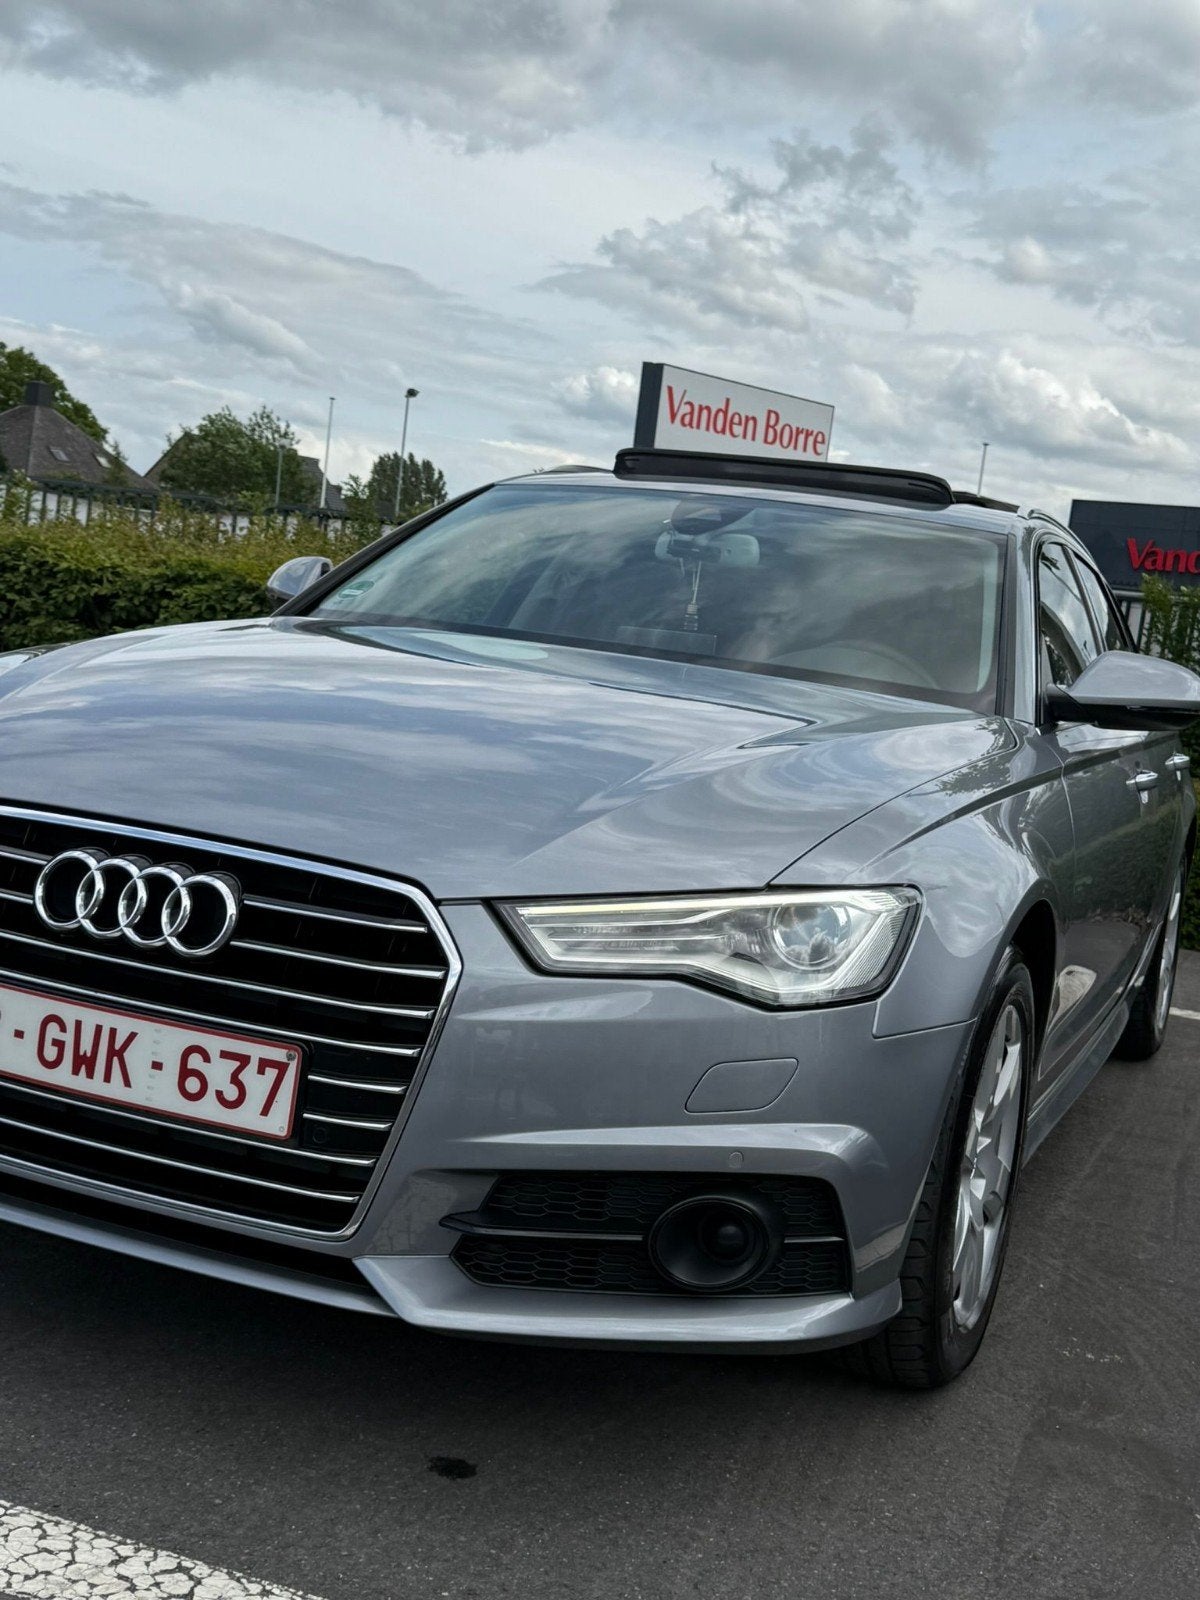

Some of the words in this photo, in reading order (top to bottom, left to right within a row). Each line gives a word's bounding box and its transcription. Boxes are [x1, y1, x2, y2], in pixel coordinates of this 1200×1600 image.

[667, 385, 758, 442] Vanden
[763, 408, 826, 456] Borre
[0, 1008, 291, 1118] -GWK-637
